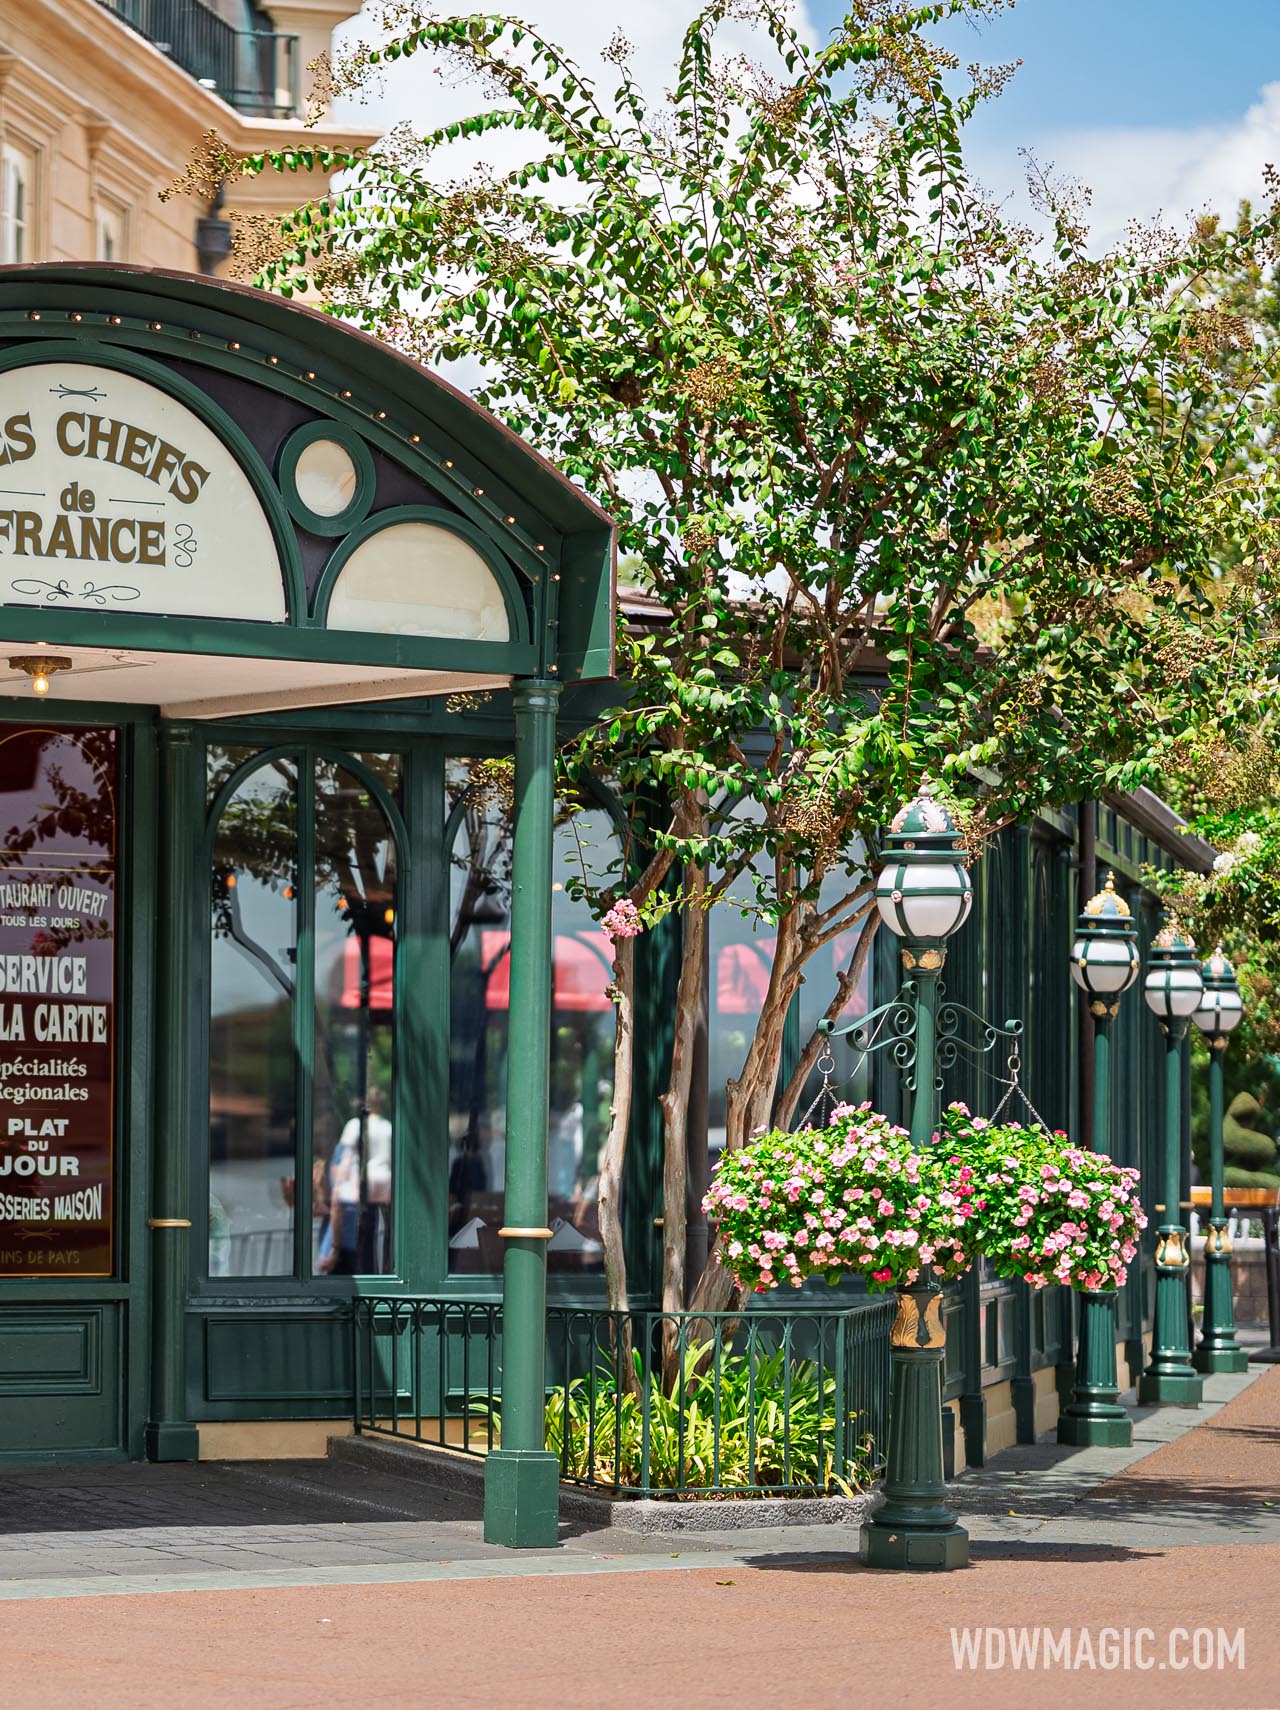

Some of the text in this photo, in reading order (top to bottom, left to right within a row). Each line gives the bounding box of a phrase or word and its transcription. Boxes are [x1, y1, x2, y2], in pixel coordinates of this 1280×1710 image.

[57, 411, 211, 504] CHEFS
[60, 481, 95, 513] de
[58, 885, 108, 917] OUVERT
[0, 915, 80, 928] TOUS LES JOURS
[34, 1004, 107, 1043] CARTE
[7, 1118, 69, 1136] PLAT
[28, 1140, 49, 1151] DU
[54, 1183, 102, 1220] MAISON
